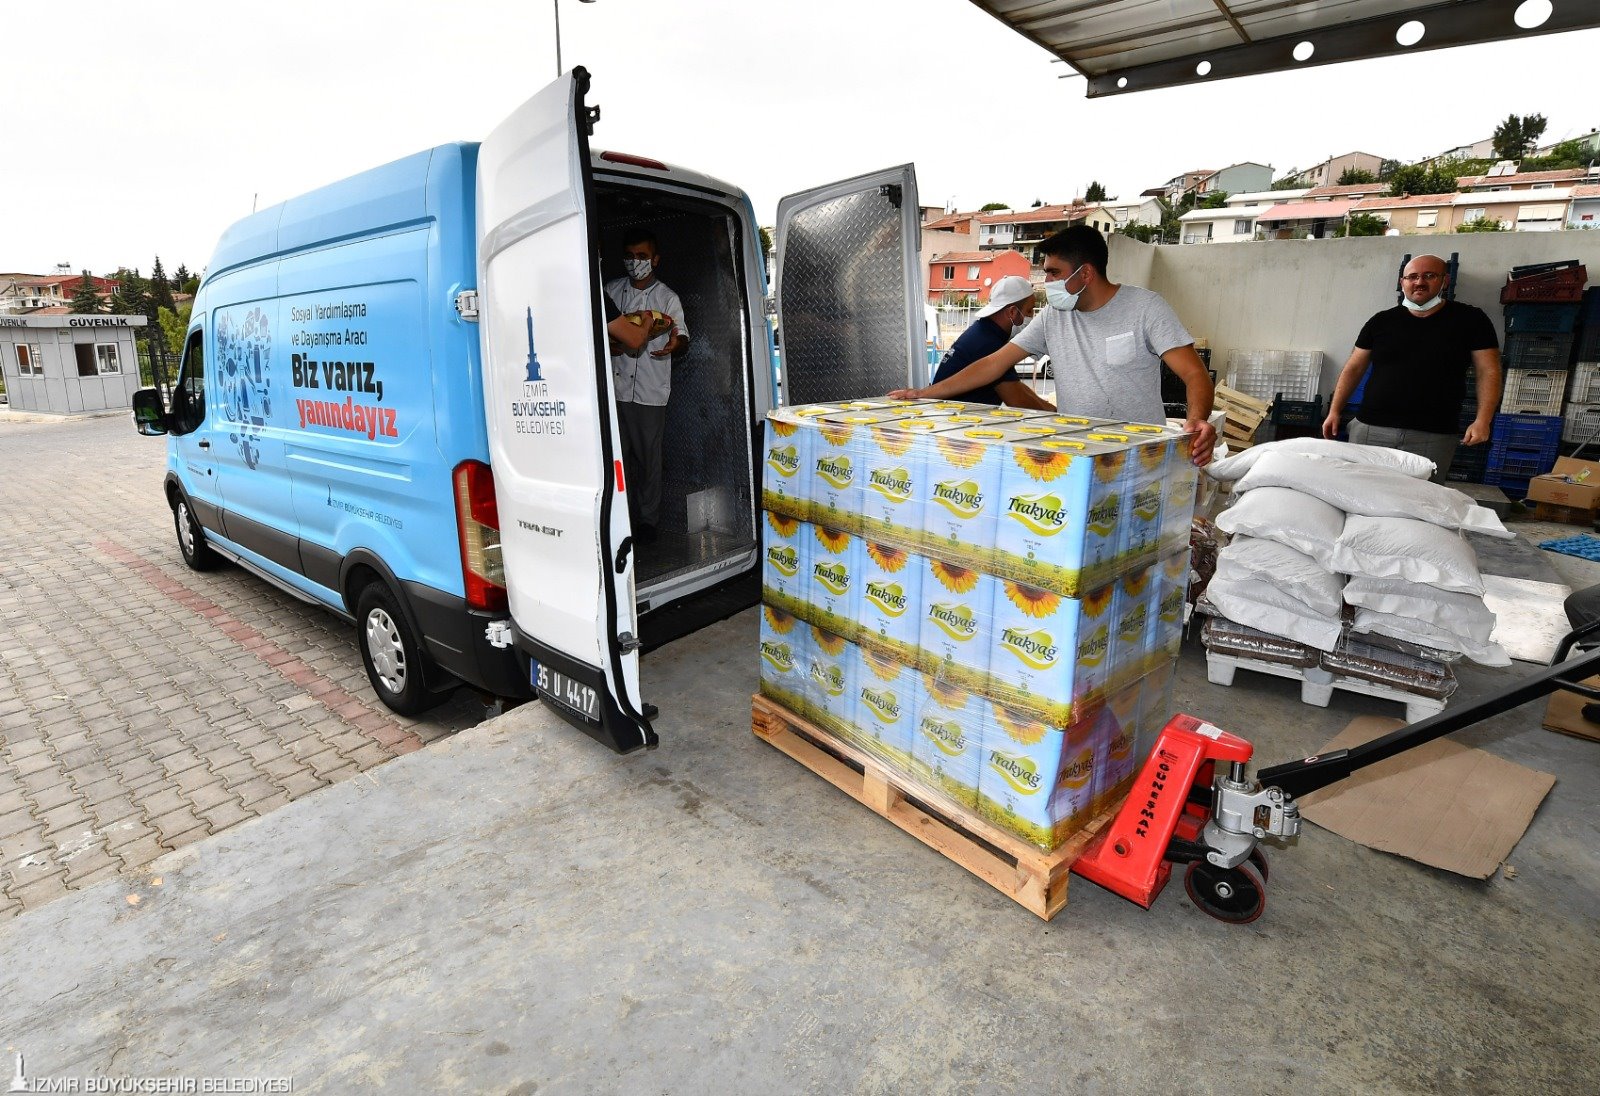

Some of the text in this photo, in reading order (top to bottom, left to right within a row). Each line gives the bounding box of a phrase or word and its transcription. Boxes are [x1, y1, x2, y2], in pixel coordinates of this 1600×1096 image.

[69, 316, 128, 327] GÜVENLİK
[291, 301, 367, 323] Sosyal Yardımlaşma
[291, 328, 367, 348] ve Dayanışma Aracı
[291, 352, 384, 402] Biz varız,
[522, 382, 549, 398] İZMİR
[296, 395, 399, 441] yanındayız
[511, 399, 567, 418] BÜYÜKŞEHİR
[515, 419, 566, 435] BELEDİYESİ
[767, 448, 799, 469] Trakyağ
[816, 458, 854, 481] Trakyağ
[869, 470, 913, 494] Trakyağ
[933, 482, 984, 509] Trakyağ
[1008, 497, 1068, 526] Trakyağ
[767, 548, 798, 569] Trakyağ
[814, 562, 851, 588] Trakyağ
[866, 582, 907, 610] Trakyağ
[929, 602, 979, 633] Trakyağ
[1001, 628, 1058, 661] Trakyağ
[537, 663, 548, 690] 35
[553, 671, 560, 697] U
[566, 679, 596, 714] 4417
[861, 686, 901, 717] Trakyağ
[920, 716, 968, 749] Trakyağ
[989, 749, 1043, 788] Trakyağ
